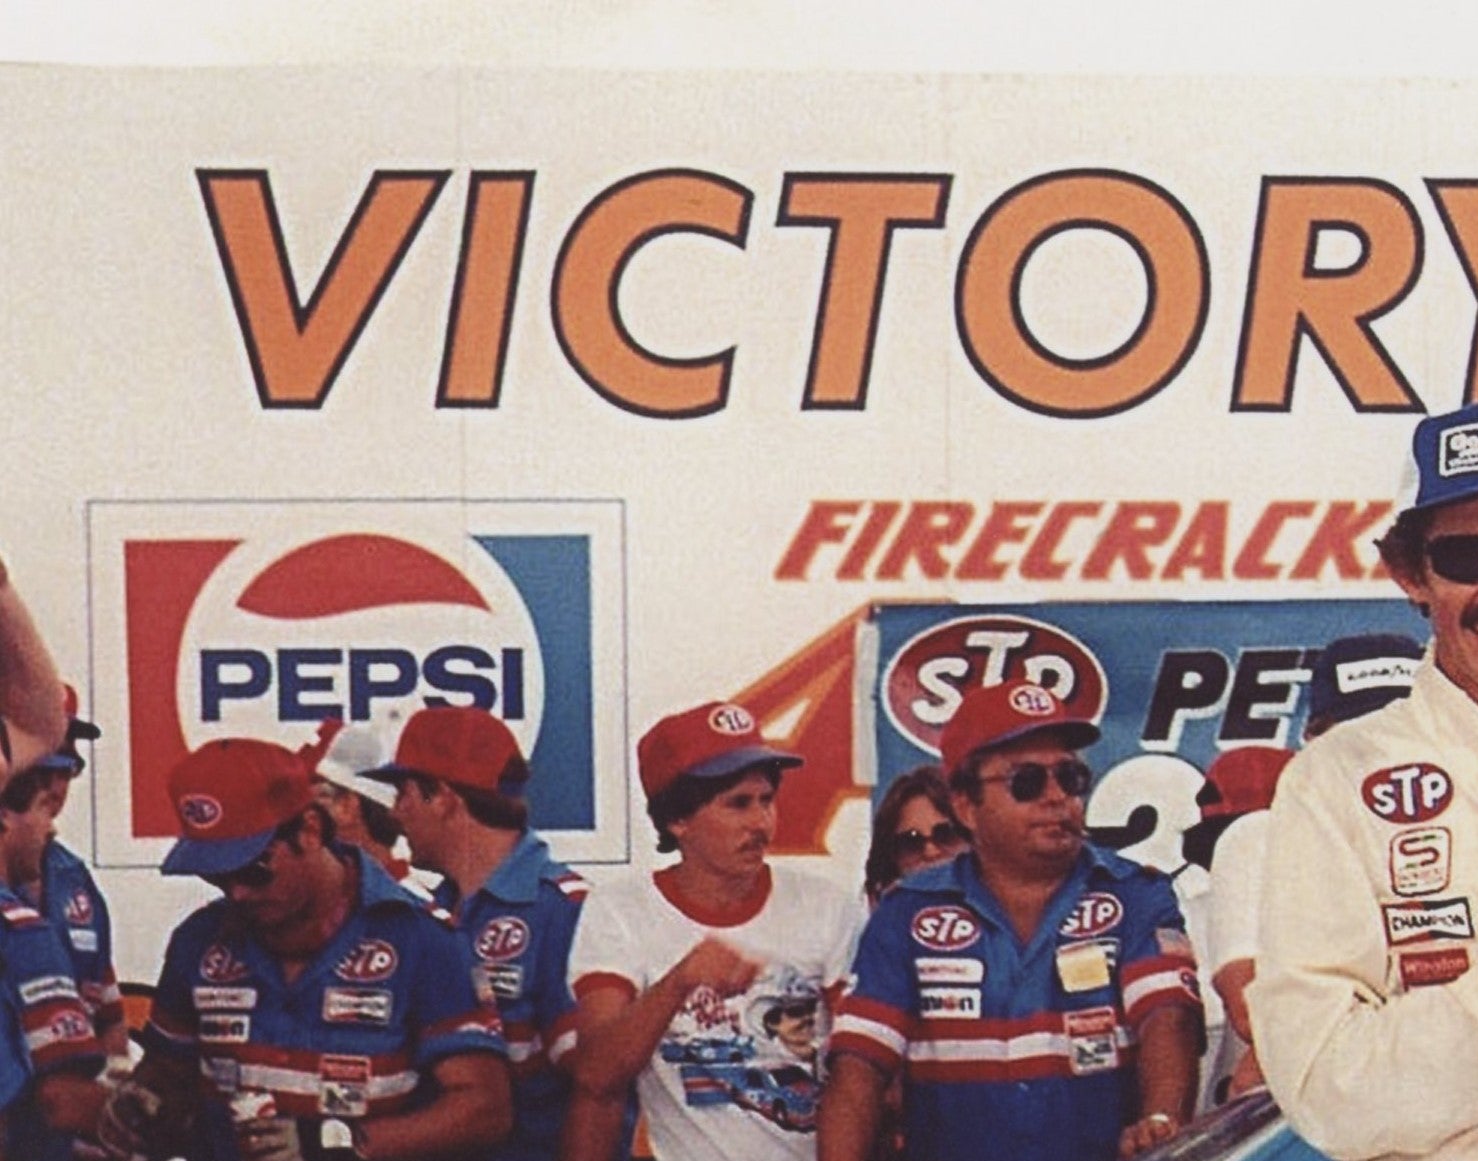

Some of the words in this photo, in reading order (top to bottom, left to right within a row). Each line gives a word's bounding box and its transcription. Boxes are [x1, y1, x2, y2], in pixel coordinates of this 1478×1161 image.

[773, 500, 1395, 581] FIRECRACK
[200, 645, 524, 722] PEPSI
[910, 631, 1076, 724] STP
[1140, 647, 1326, 750] PE
[1372, 767, 1448, 816] STP
[477, 920, 524, 957] STP
[919, 910, 975, 943] STP
[1062, 898, 1112, 936] STP
